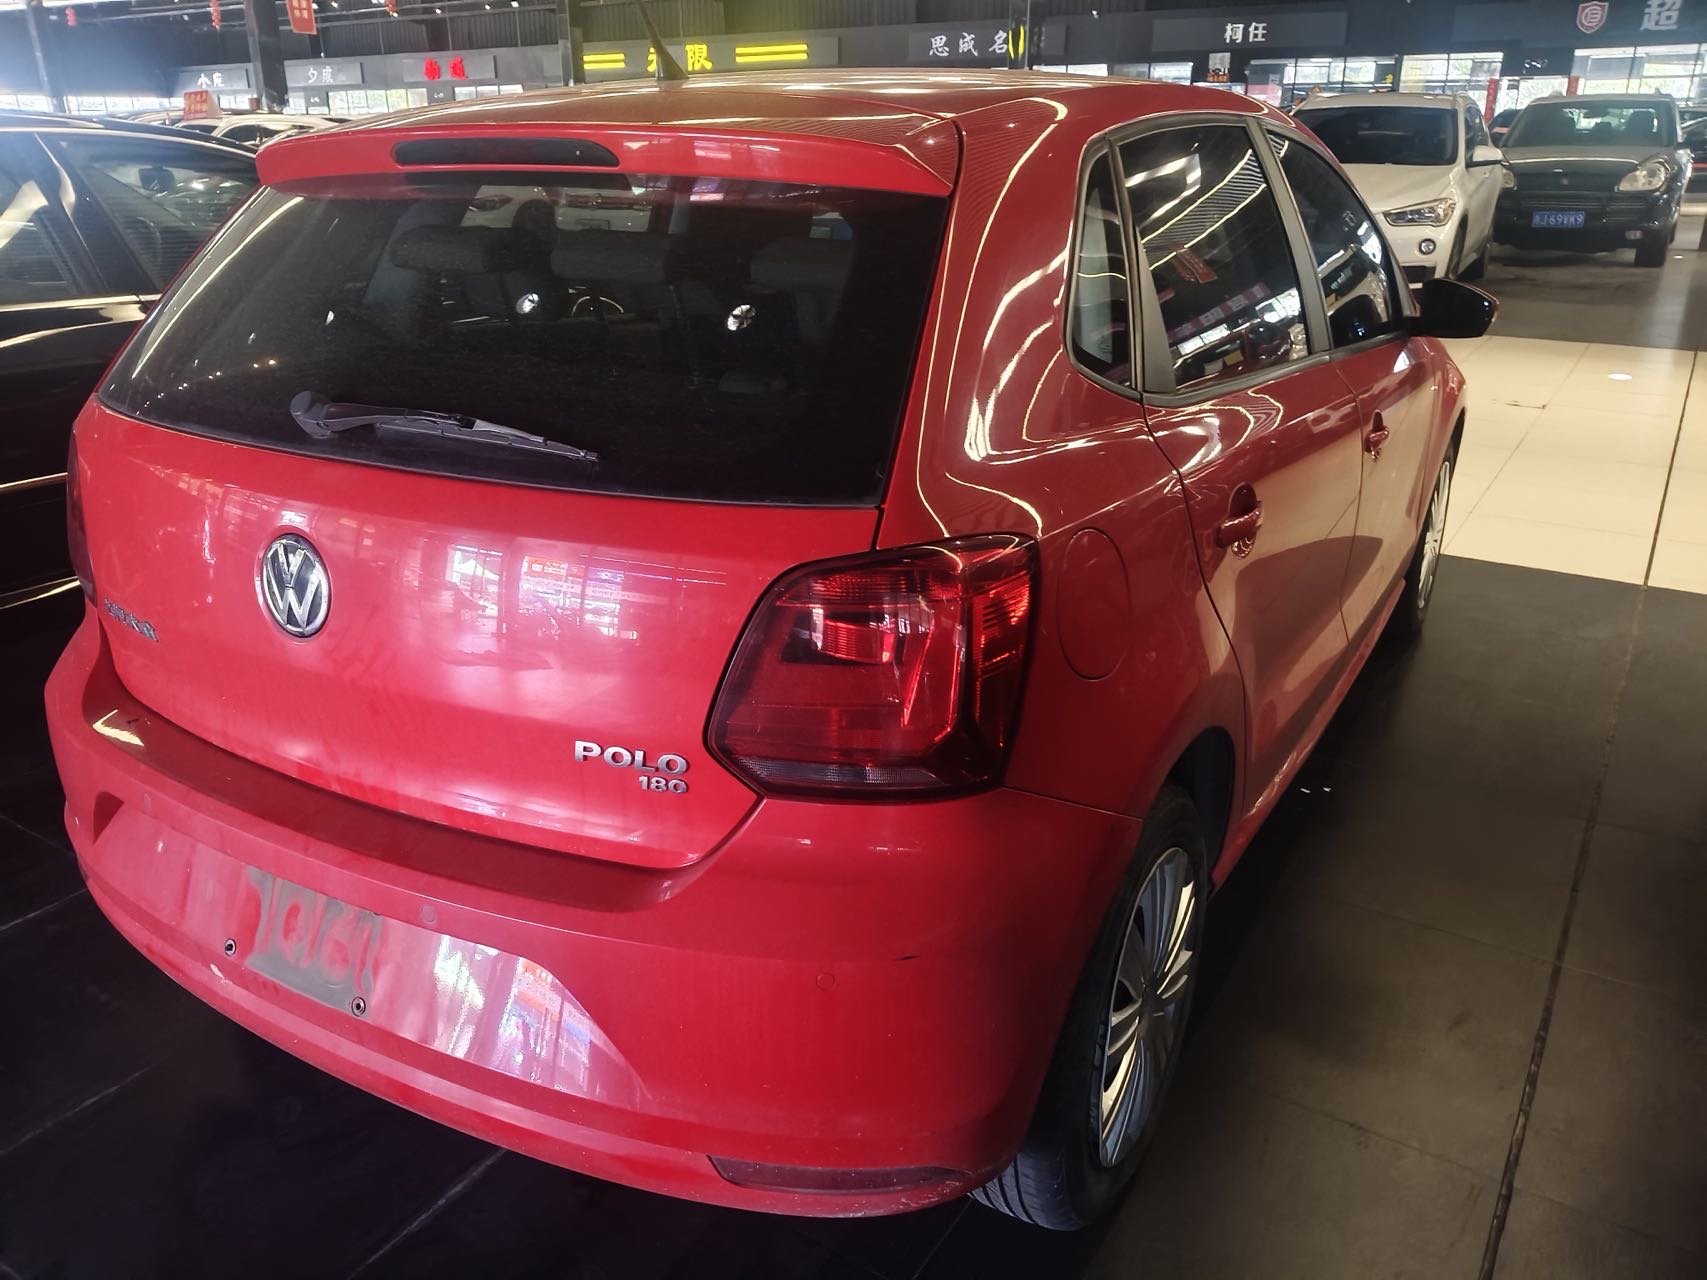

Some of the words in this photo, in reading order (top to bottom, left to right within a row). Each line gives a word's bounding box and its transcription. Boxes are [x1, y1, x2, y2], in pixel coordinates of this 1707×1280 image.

[928, 30, 1008, 57] 思成名
[1223, 22, 1268, 43] 柯任
[575, 740, 689, 775] POLO
[638, 775, 688, 794] 180
